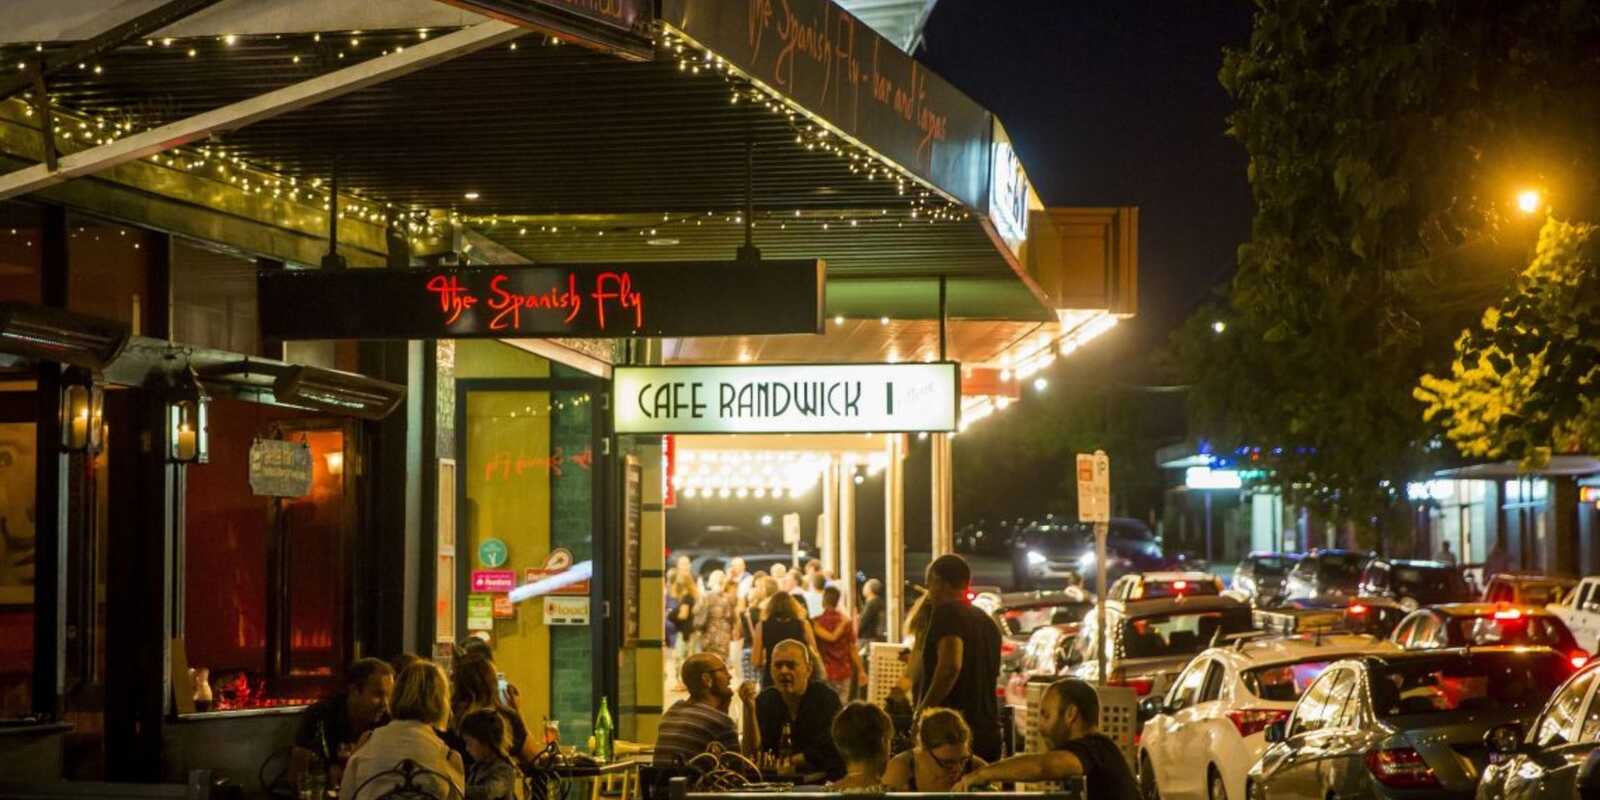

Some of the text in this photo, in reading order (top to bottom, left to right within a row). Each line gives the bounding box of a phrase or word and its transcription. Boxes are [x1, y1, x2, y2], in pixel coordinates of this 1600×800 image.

[777, 0, 832, 105] Spanish
[835, 11, 860, 133] Fly
[872, 36, 892, 104] bar
[894, 60, 918, 120] and
[916, 73, 947, 166] tapas
[426, 271, 643, 330] The Spanish Fly
[638, 380, 861, 418] CAFE RANDWICK
